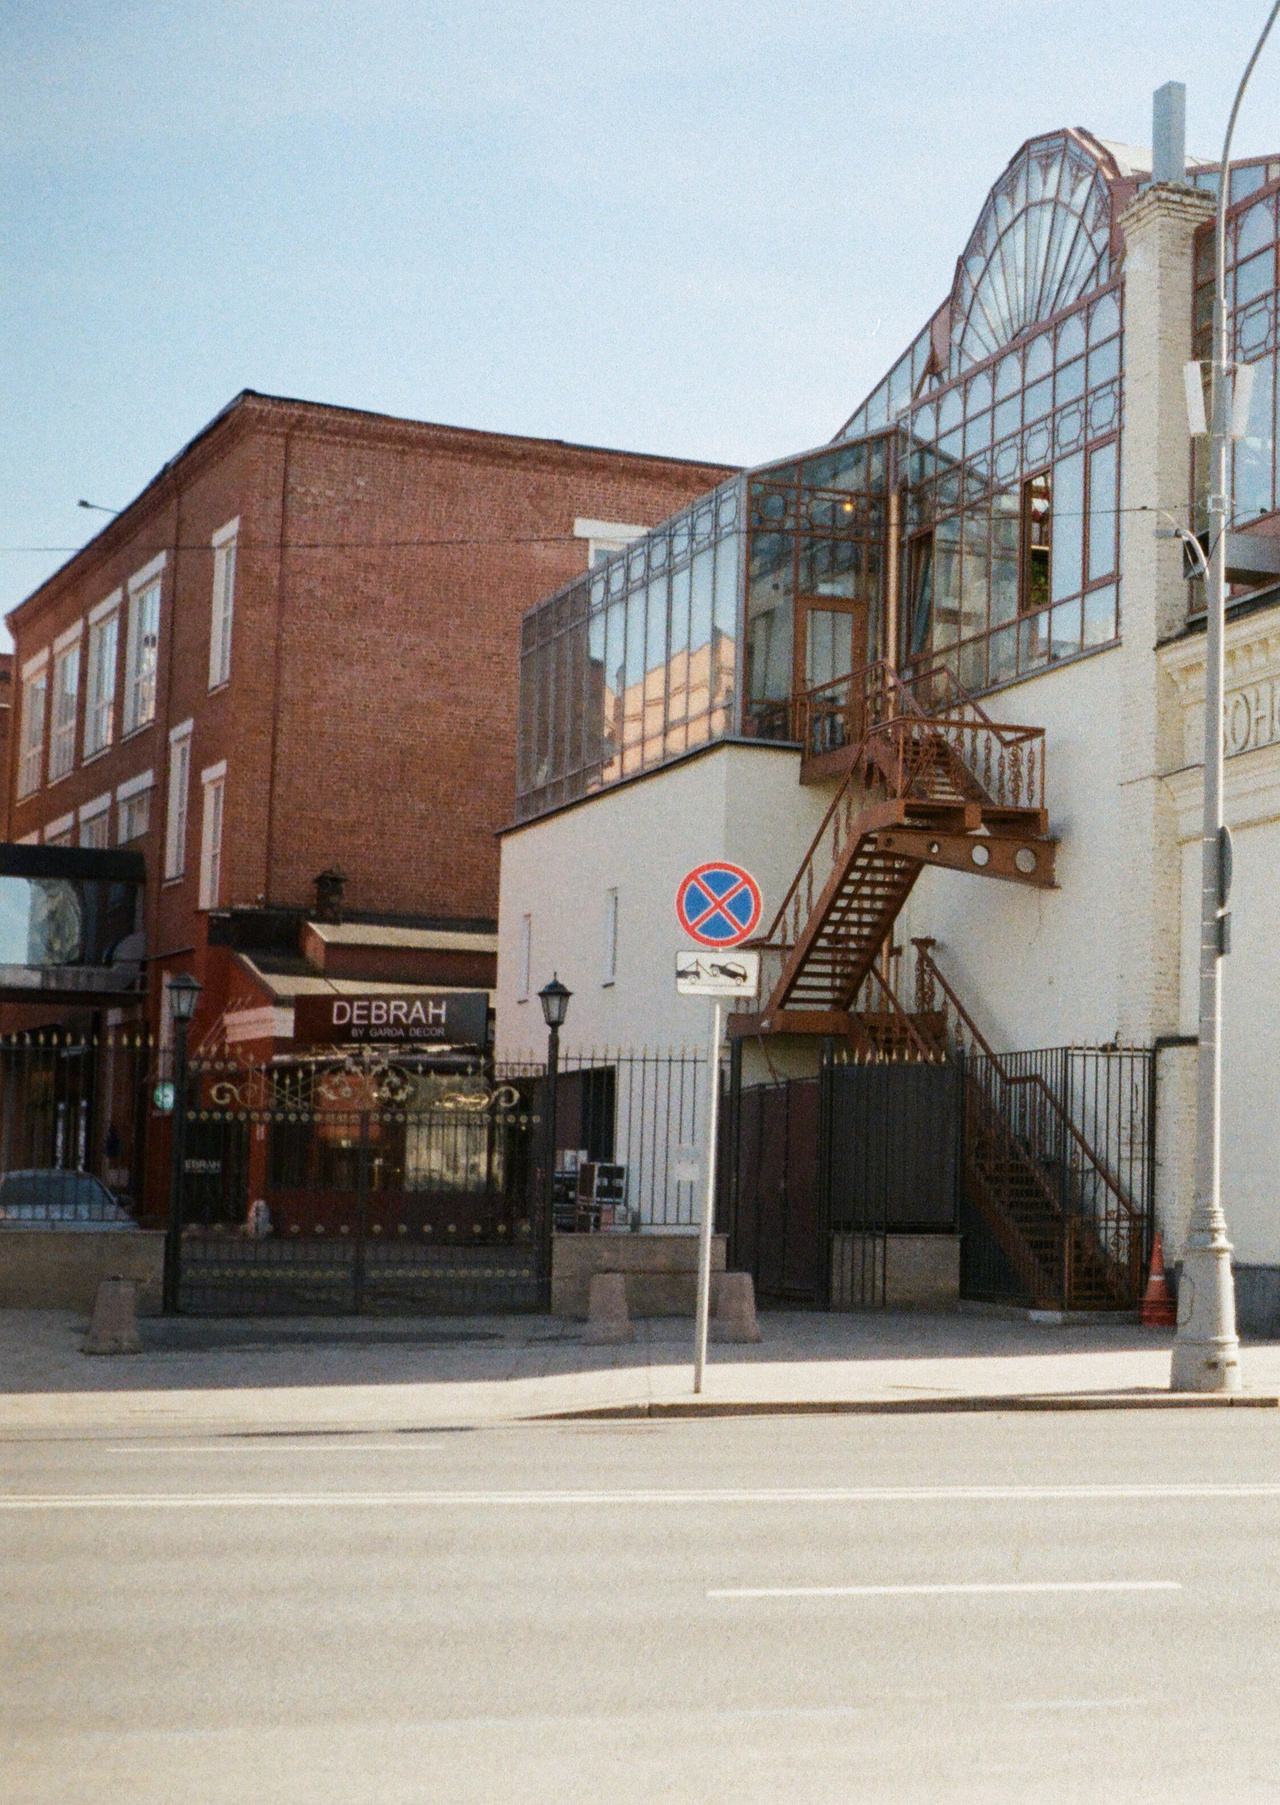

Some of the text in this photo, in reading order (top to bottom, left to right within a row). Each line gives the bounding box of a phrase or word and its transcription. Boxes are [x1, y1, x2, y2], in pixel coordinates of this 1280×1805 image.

[332, 1000, 447, 1025] DEBRAH
[351, 1027, 445, 1037] BY GARDA DECOR
